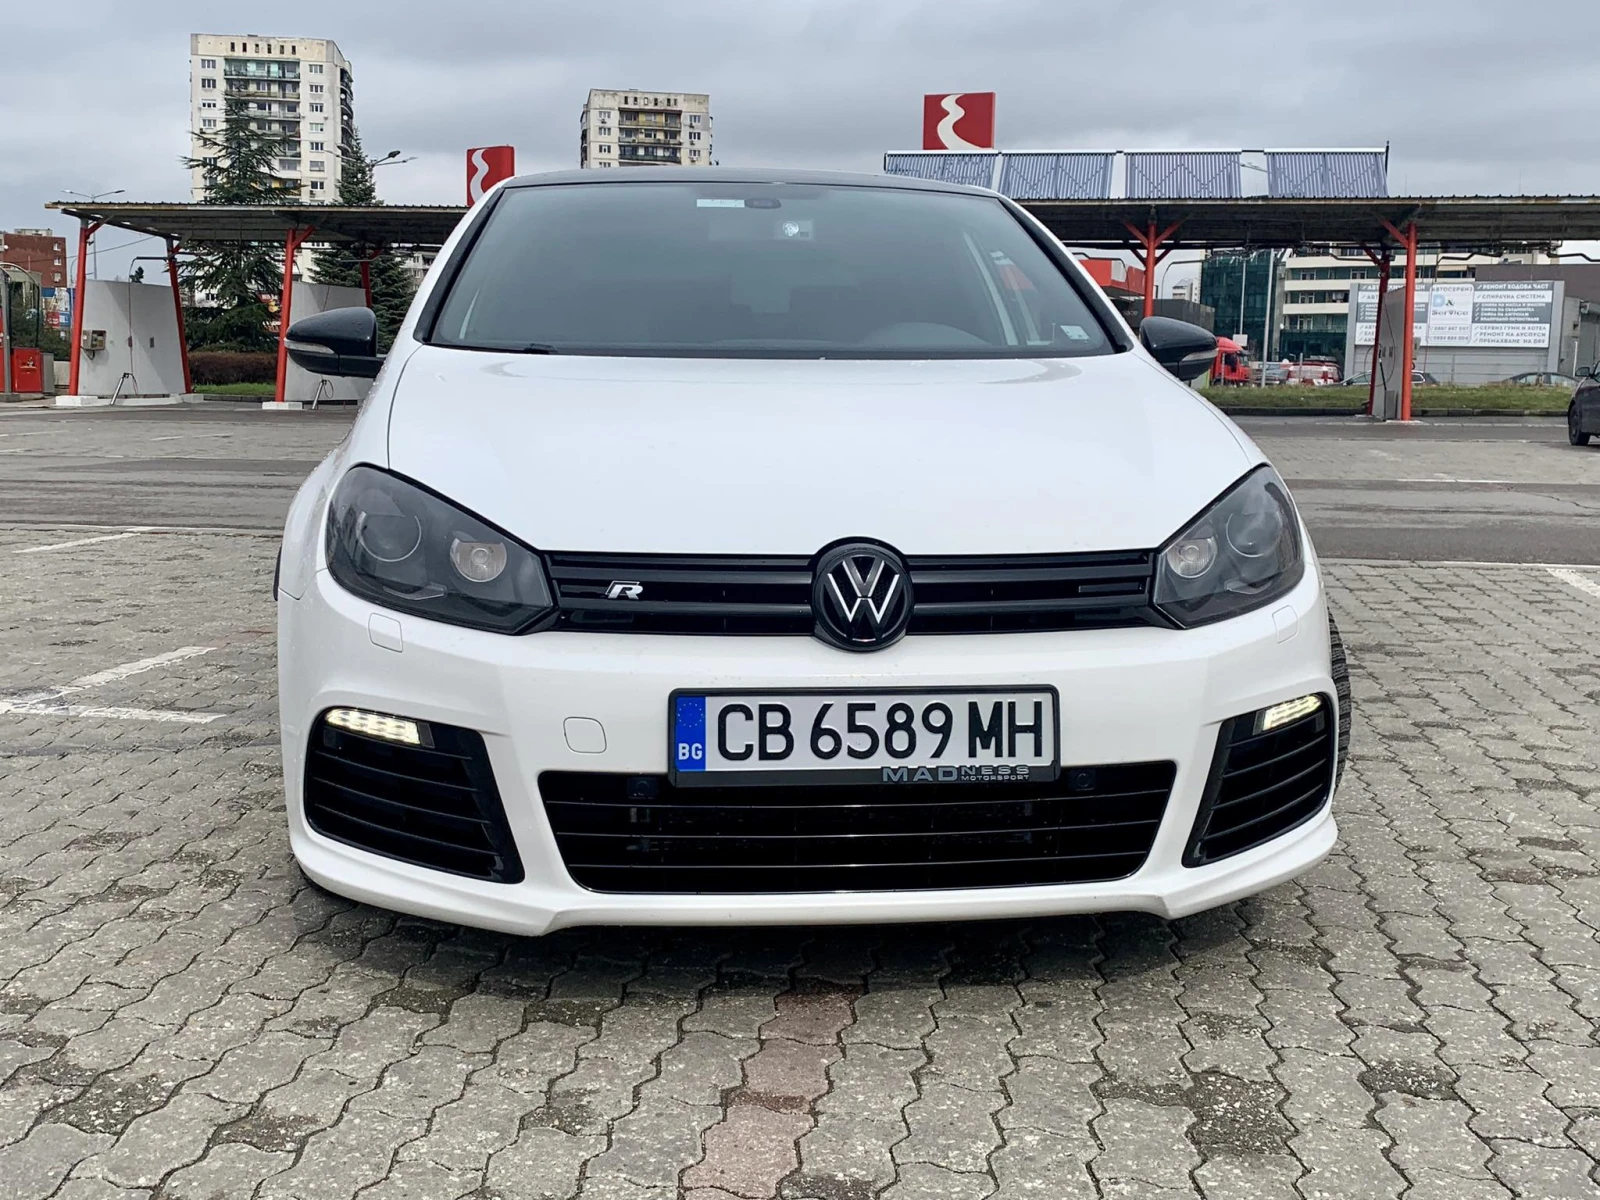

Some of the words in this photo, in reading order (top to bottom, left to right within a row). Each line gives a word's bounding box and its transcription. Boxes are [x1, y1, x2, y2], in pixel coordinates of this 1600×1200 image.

[605, 580, 643, 599] R
[718, 703, 794, 761] CB
[810, 701, 954, 759] 6589
[968, 700, 1042, 758] MH
[678, 743, 702, 760] BG
